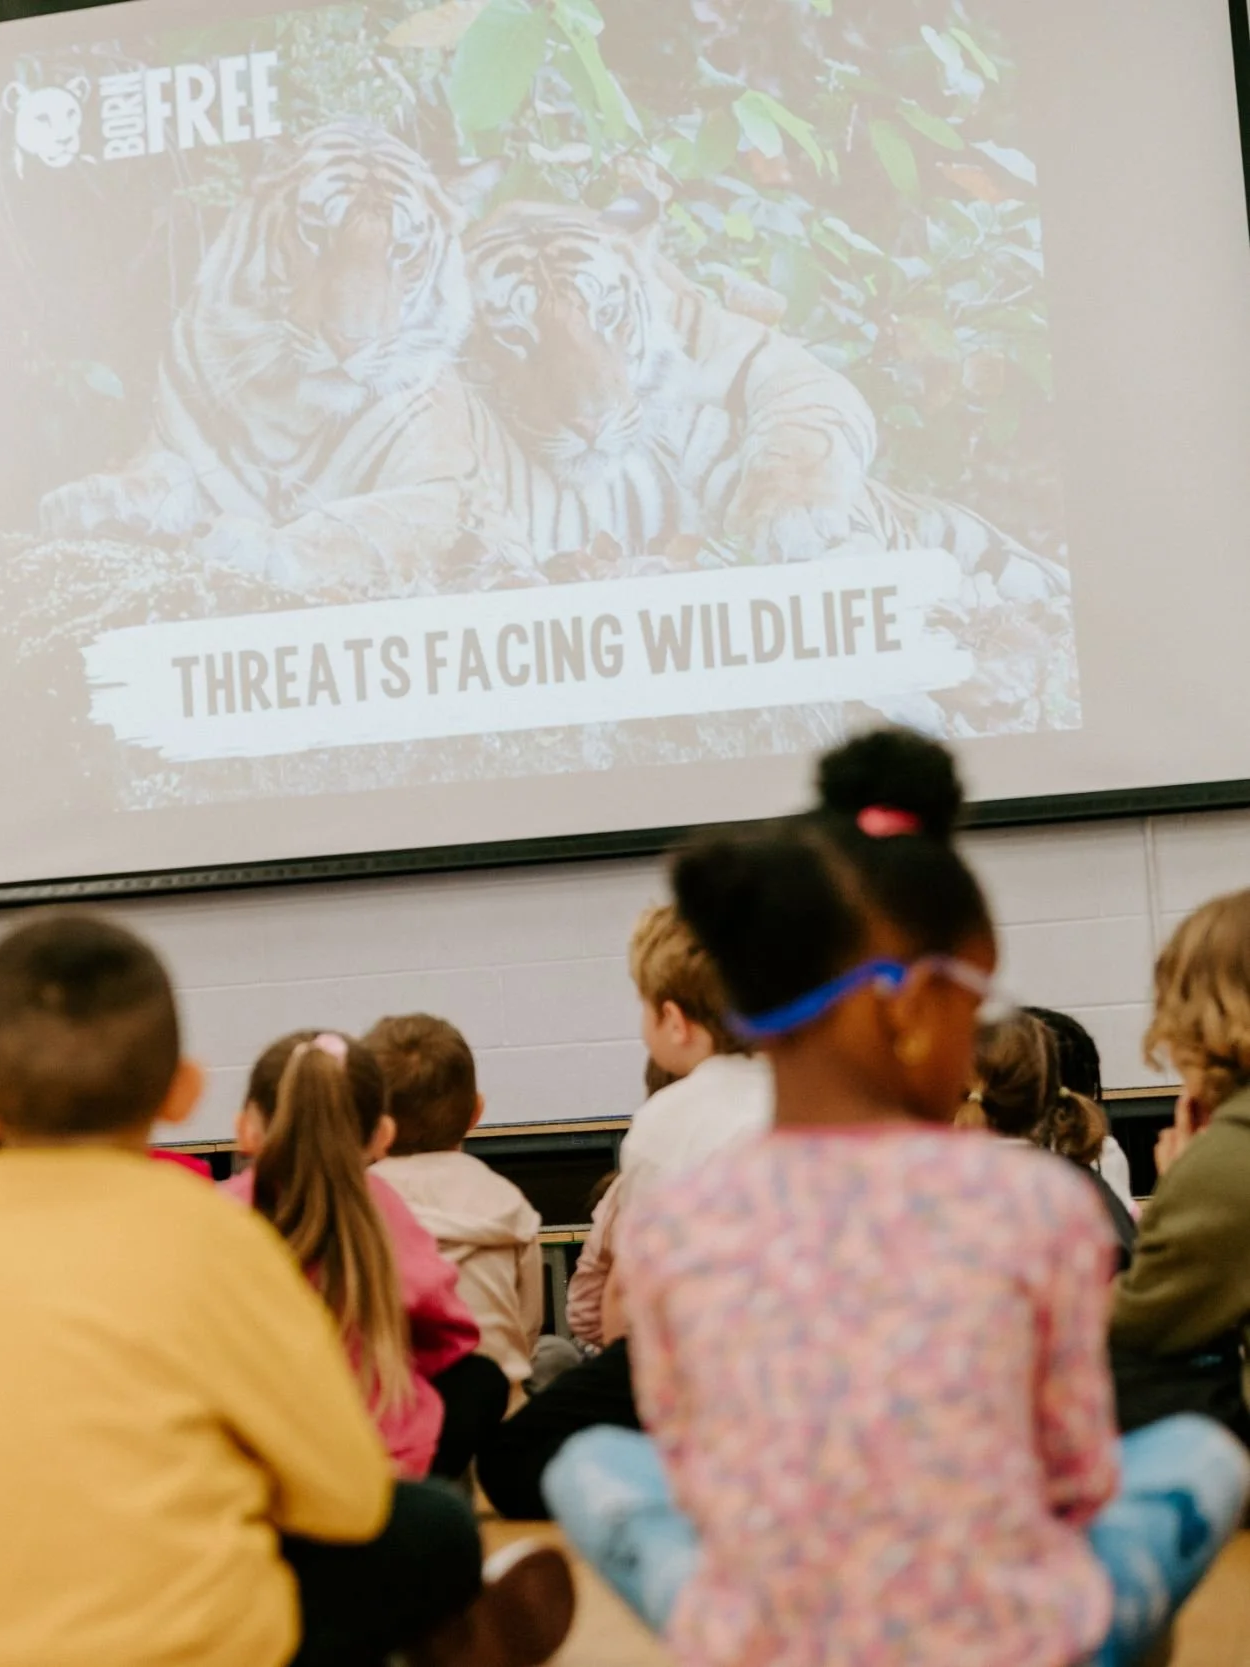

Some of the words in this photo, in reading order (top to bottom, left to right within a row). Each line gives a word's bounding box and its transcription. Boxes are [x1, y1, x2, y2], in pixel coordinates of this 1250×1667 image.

[98, 70, 146, 160] BORN
[145, 50, 282, 155] FREE
[171, 636, 411, 719] THREATS
[425, 613, 623, 696] FACING
[637, 585, 903, 676] WILDLIFE
